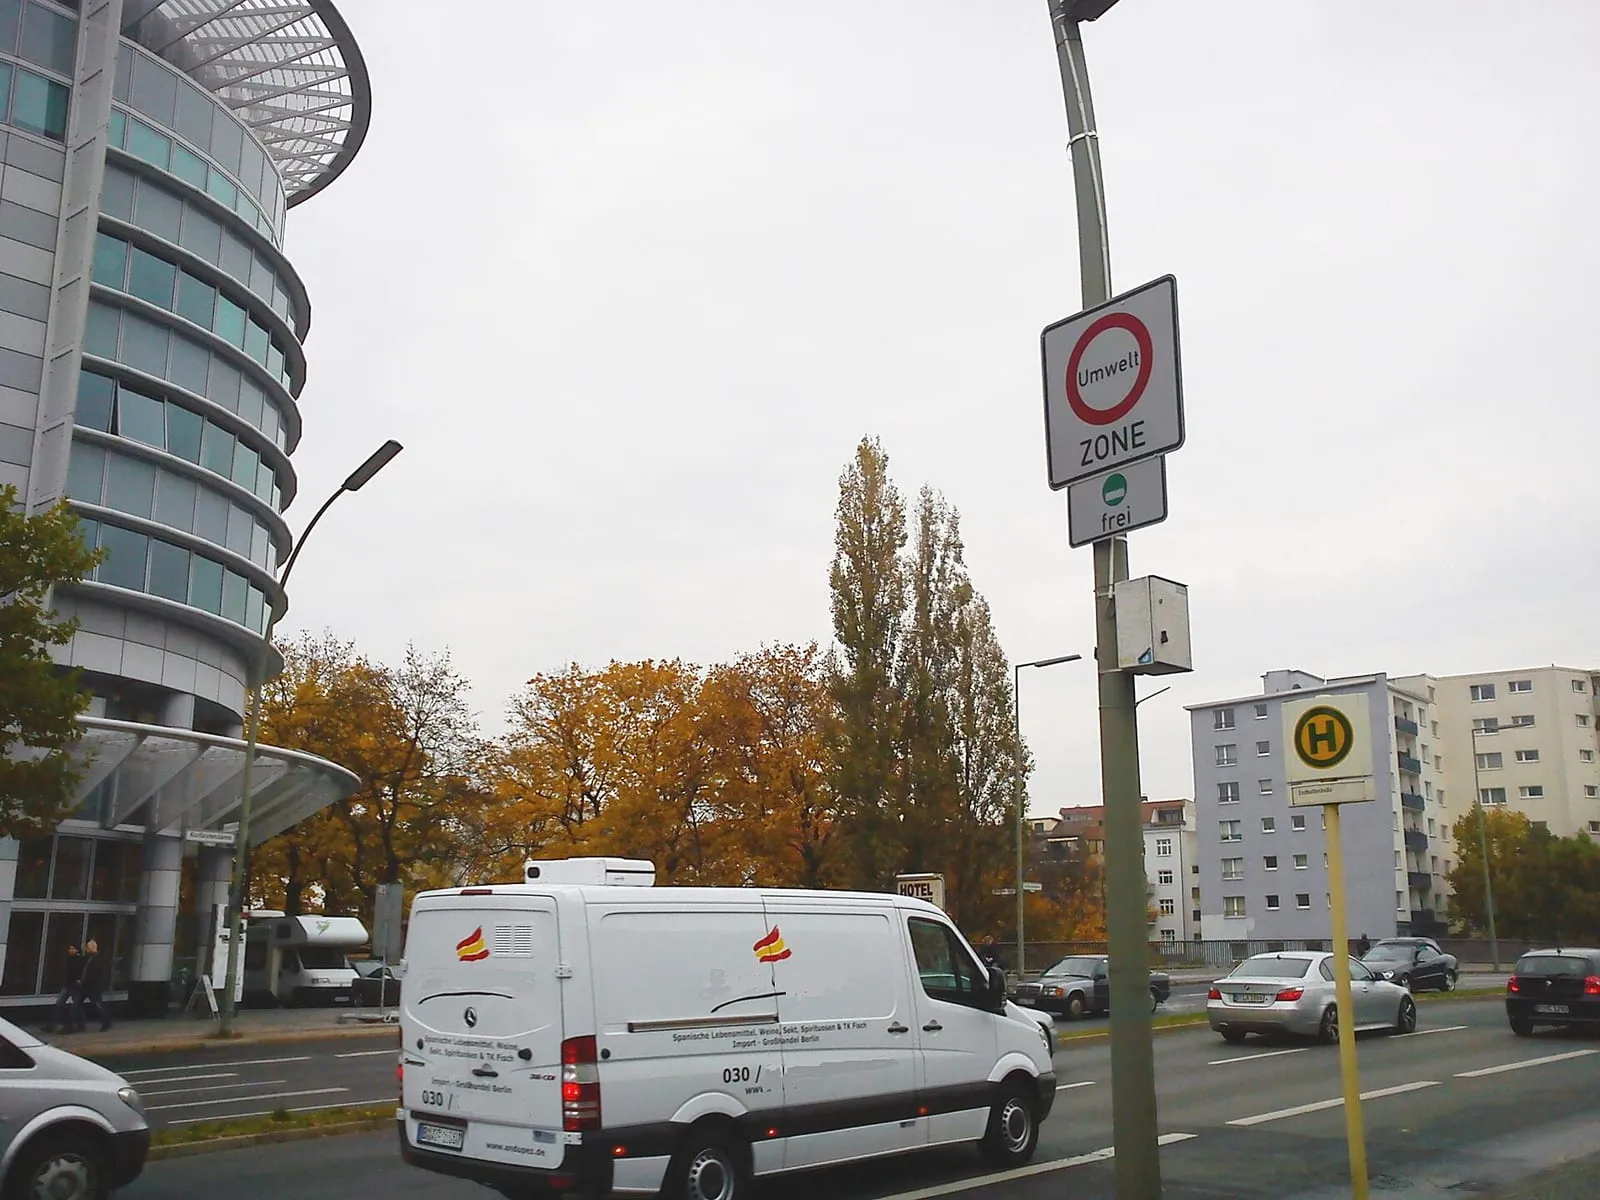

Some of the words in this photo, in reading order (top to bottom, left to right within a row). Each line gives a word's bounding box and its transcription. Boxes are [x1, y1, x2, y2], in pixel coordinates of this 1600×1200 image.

[1078, 350, 1140, 387] Umwelt
[1080, 420, 1146, 466] ZONE
[1101, 505, 1131, 532] frei
[1308, 720, 1337, 755] H
[900, 883, 933, 896] HOTEL
[673, 1032, 710, 1043] Spanische
[732, 1040, 757, 1049] Import
[801, 1035, 820, 1044] Berlin
[723, 1067, 750, 1083] 030
[422, 1090, 444, 1107] 030
